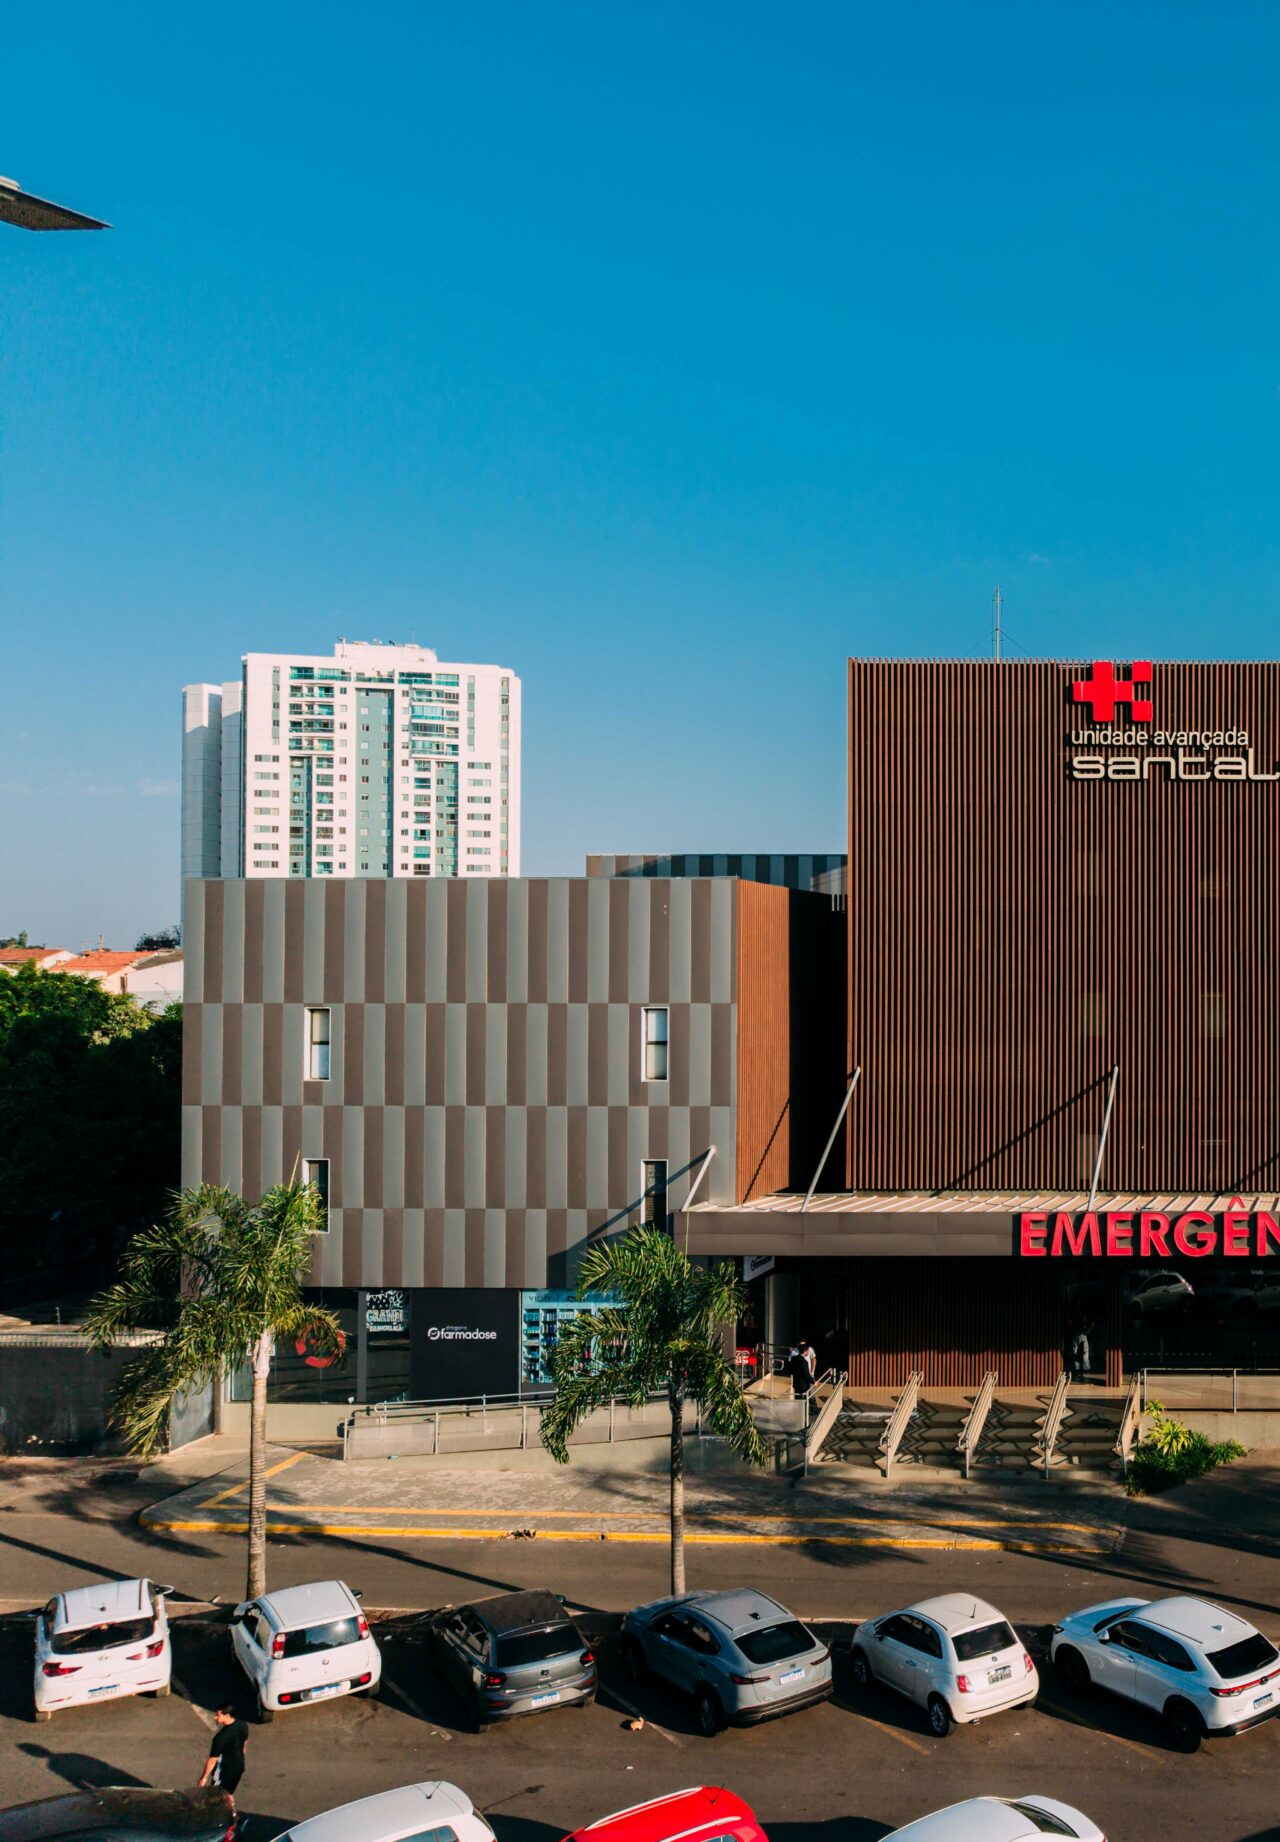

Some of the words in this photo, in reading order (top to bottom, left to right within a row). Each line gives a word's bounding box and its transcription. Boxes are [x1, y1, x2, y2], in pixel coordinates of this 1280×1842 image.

[1071, 724, 1149, 746] unidade
[1153, 725, 1249, 751] avançada
[440, 1327, 497, 1340] farmadose
